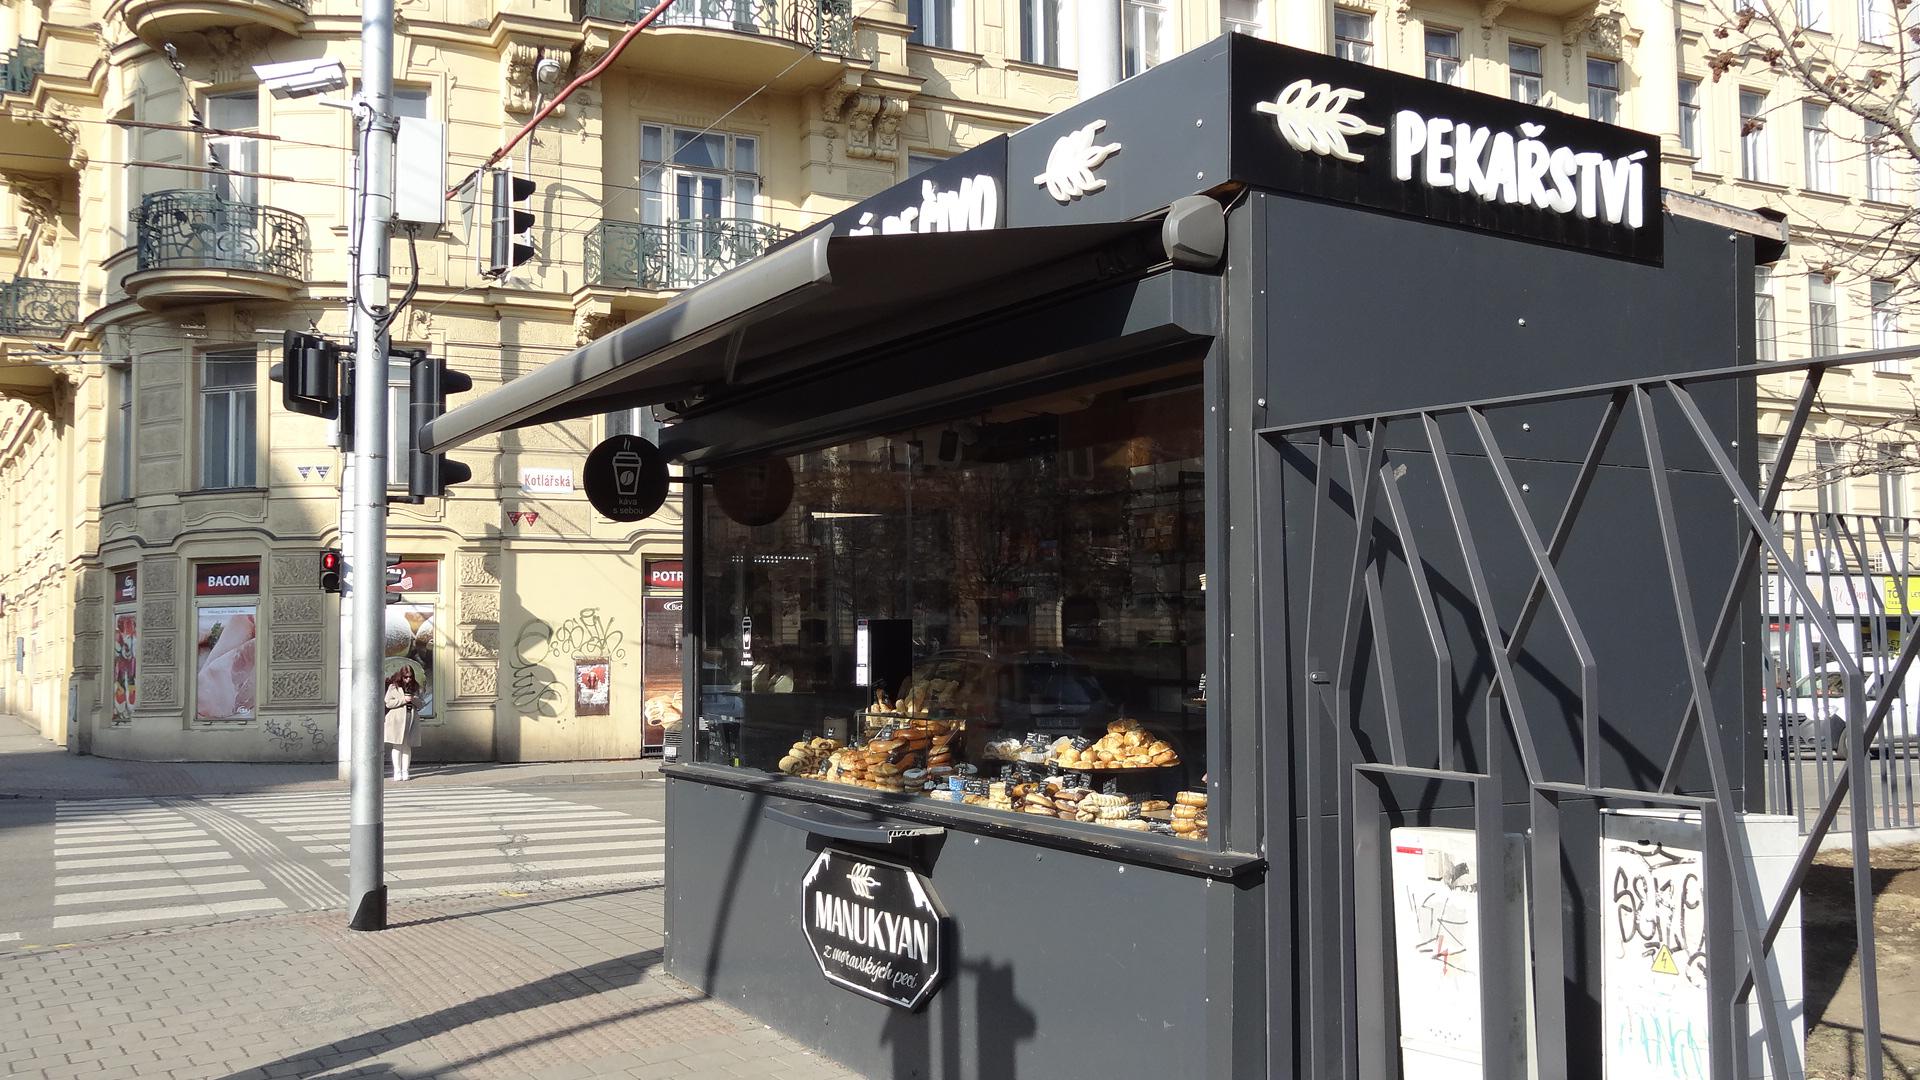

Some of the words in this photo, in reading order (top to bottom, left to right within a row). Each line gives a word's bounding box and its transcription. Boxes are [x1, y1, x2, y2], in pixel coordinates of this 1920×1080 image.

[1393, 109, 1648, 229] PEKAŘSTVÍ
[524, 473, 571, 487] Kotlářská
[207, 575, 250, 587] BACOM
[815, 891, 928, 963] MANUKYAN
[832, 946, 894, 983] moravských
